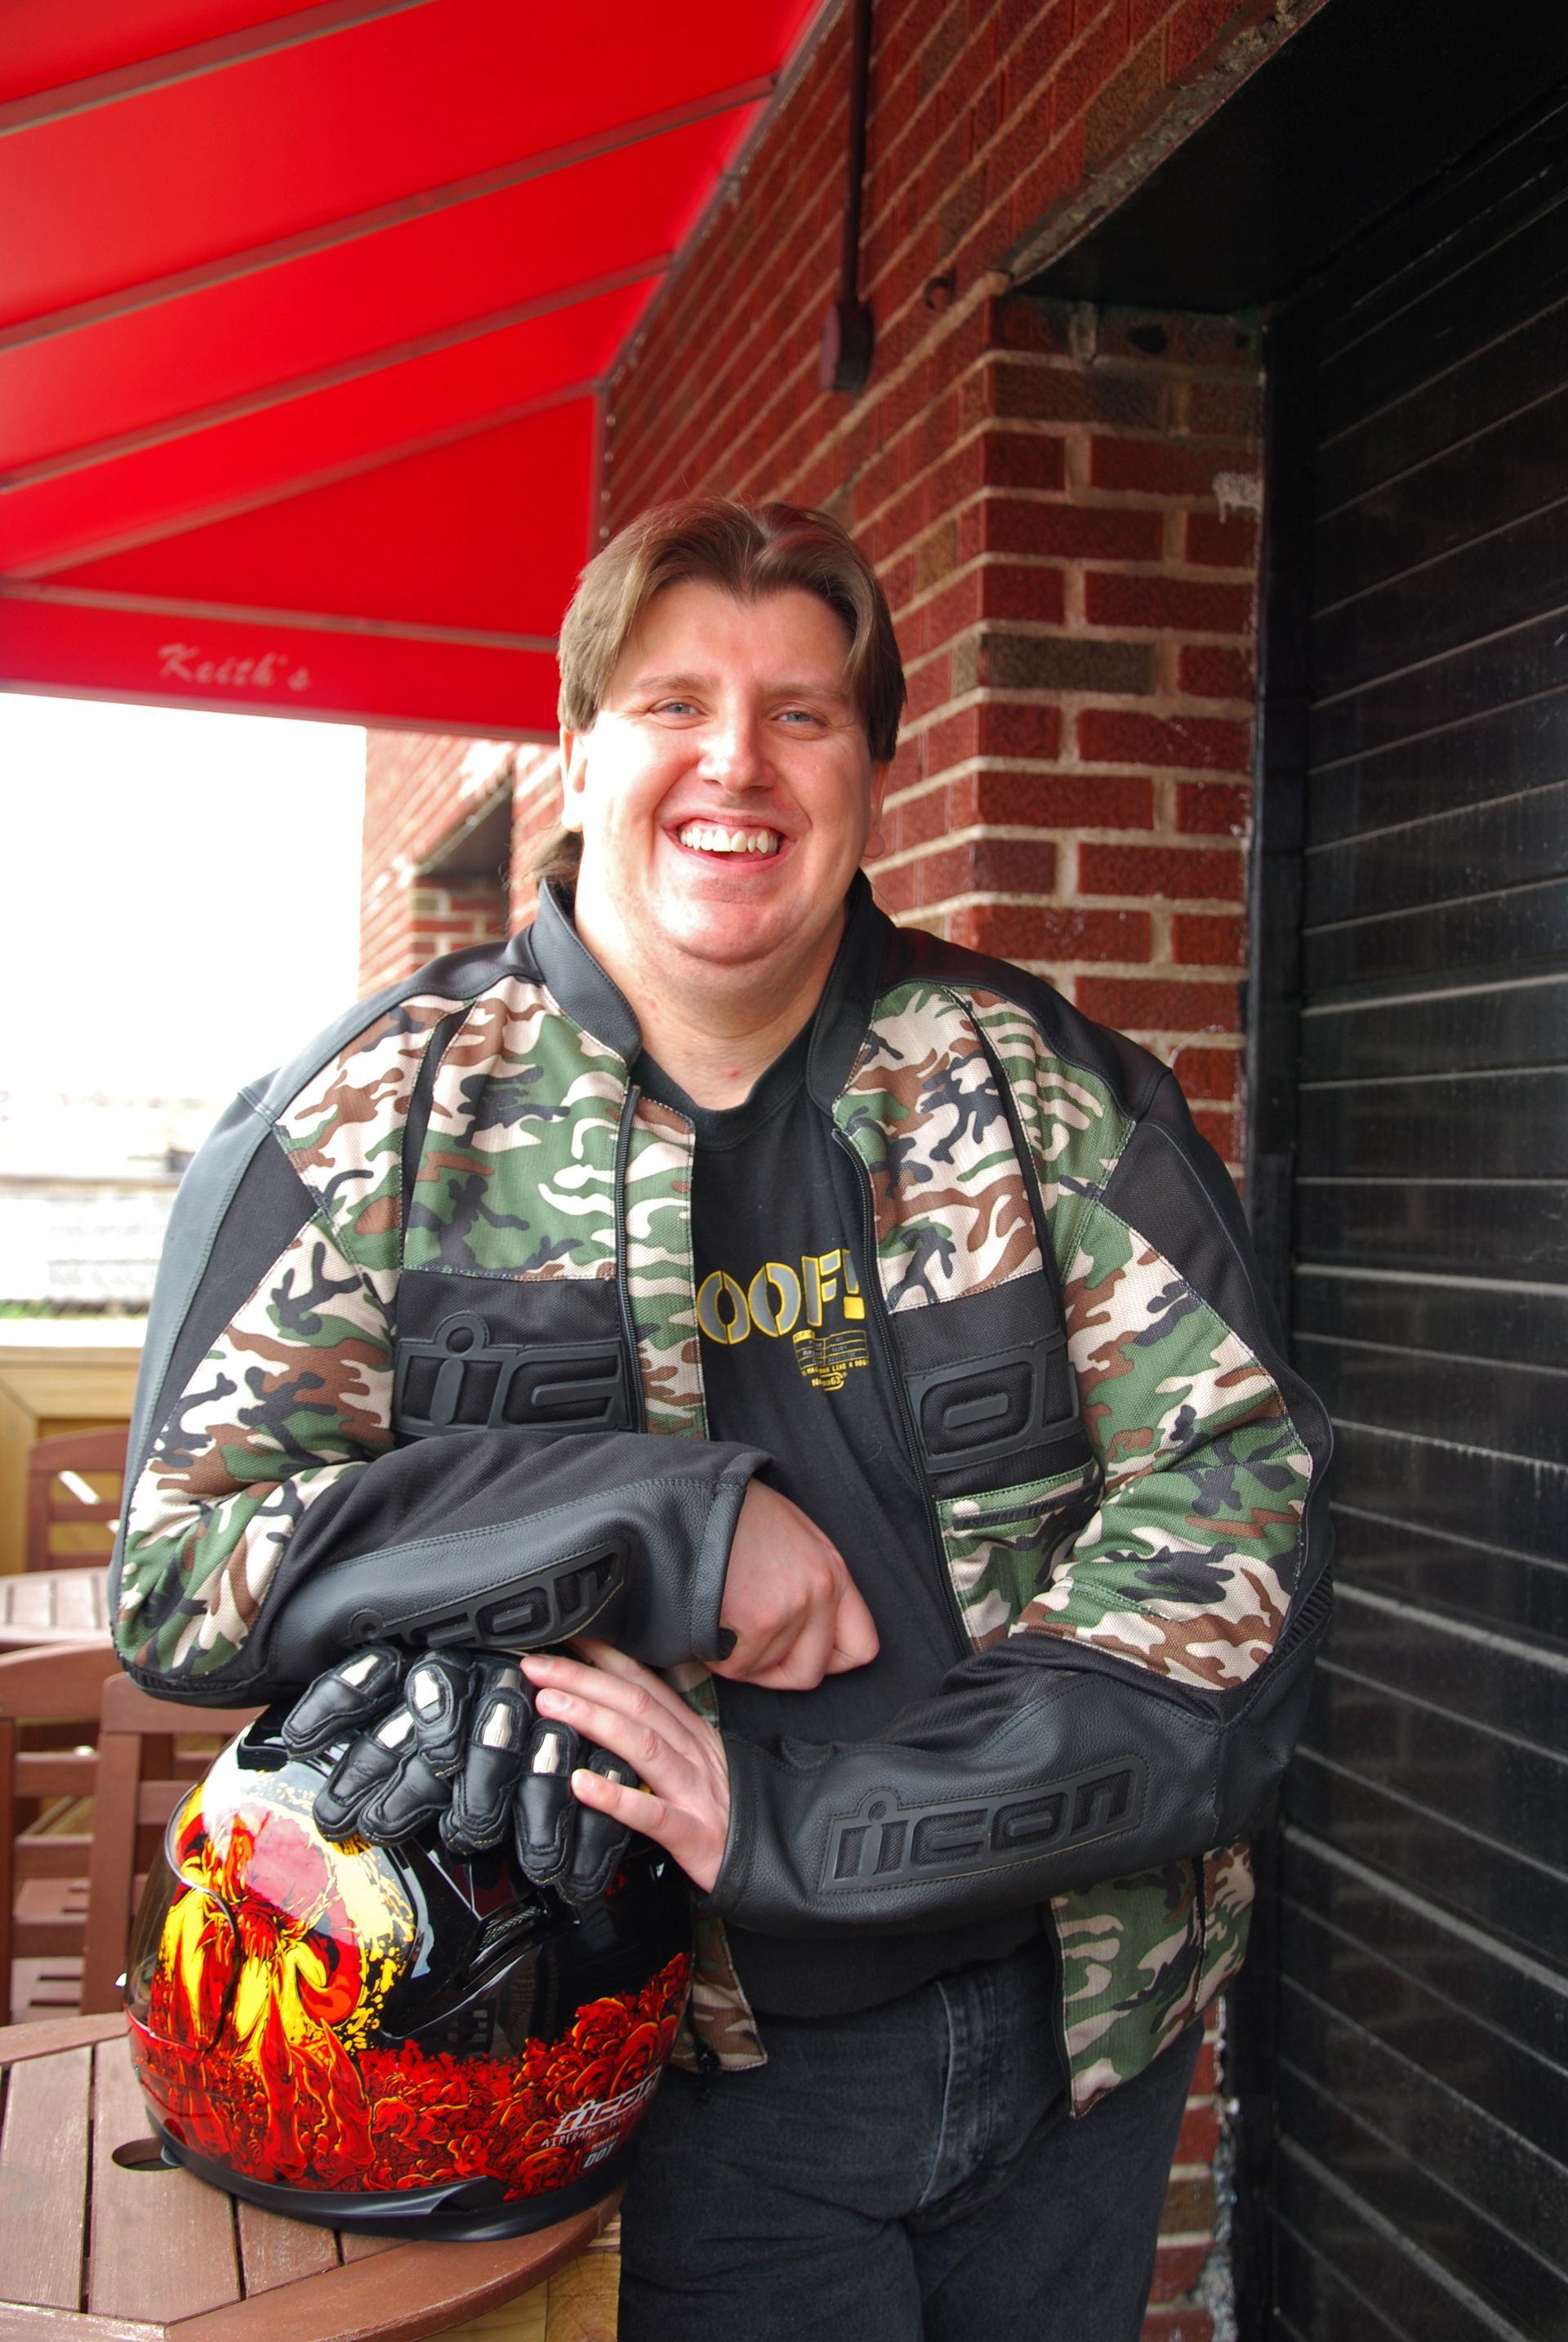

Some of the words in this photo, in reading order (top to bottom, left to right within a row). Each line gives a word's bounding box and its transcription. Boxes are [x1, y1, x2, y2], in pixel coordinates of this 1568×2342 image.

[158, 642, 311, 691] Keith's
[822, 1757, 1145, 1890] icon
[581, 2140, 617, 2170] DOT
